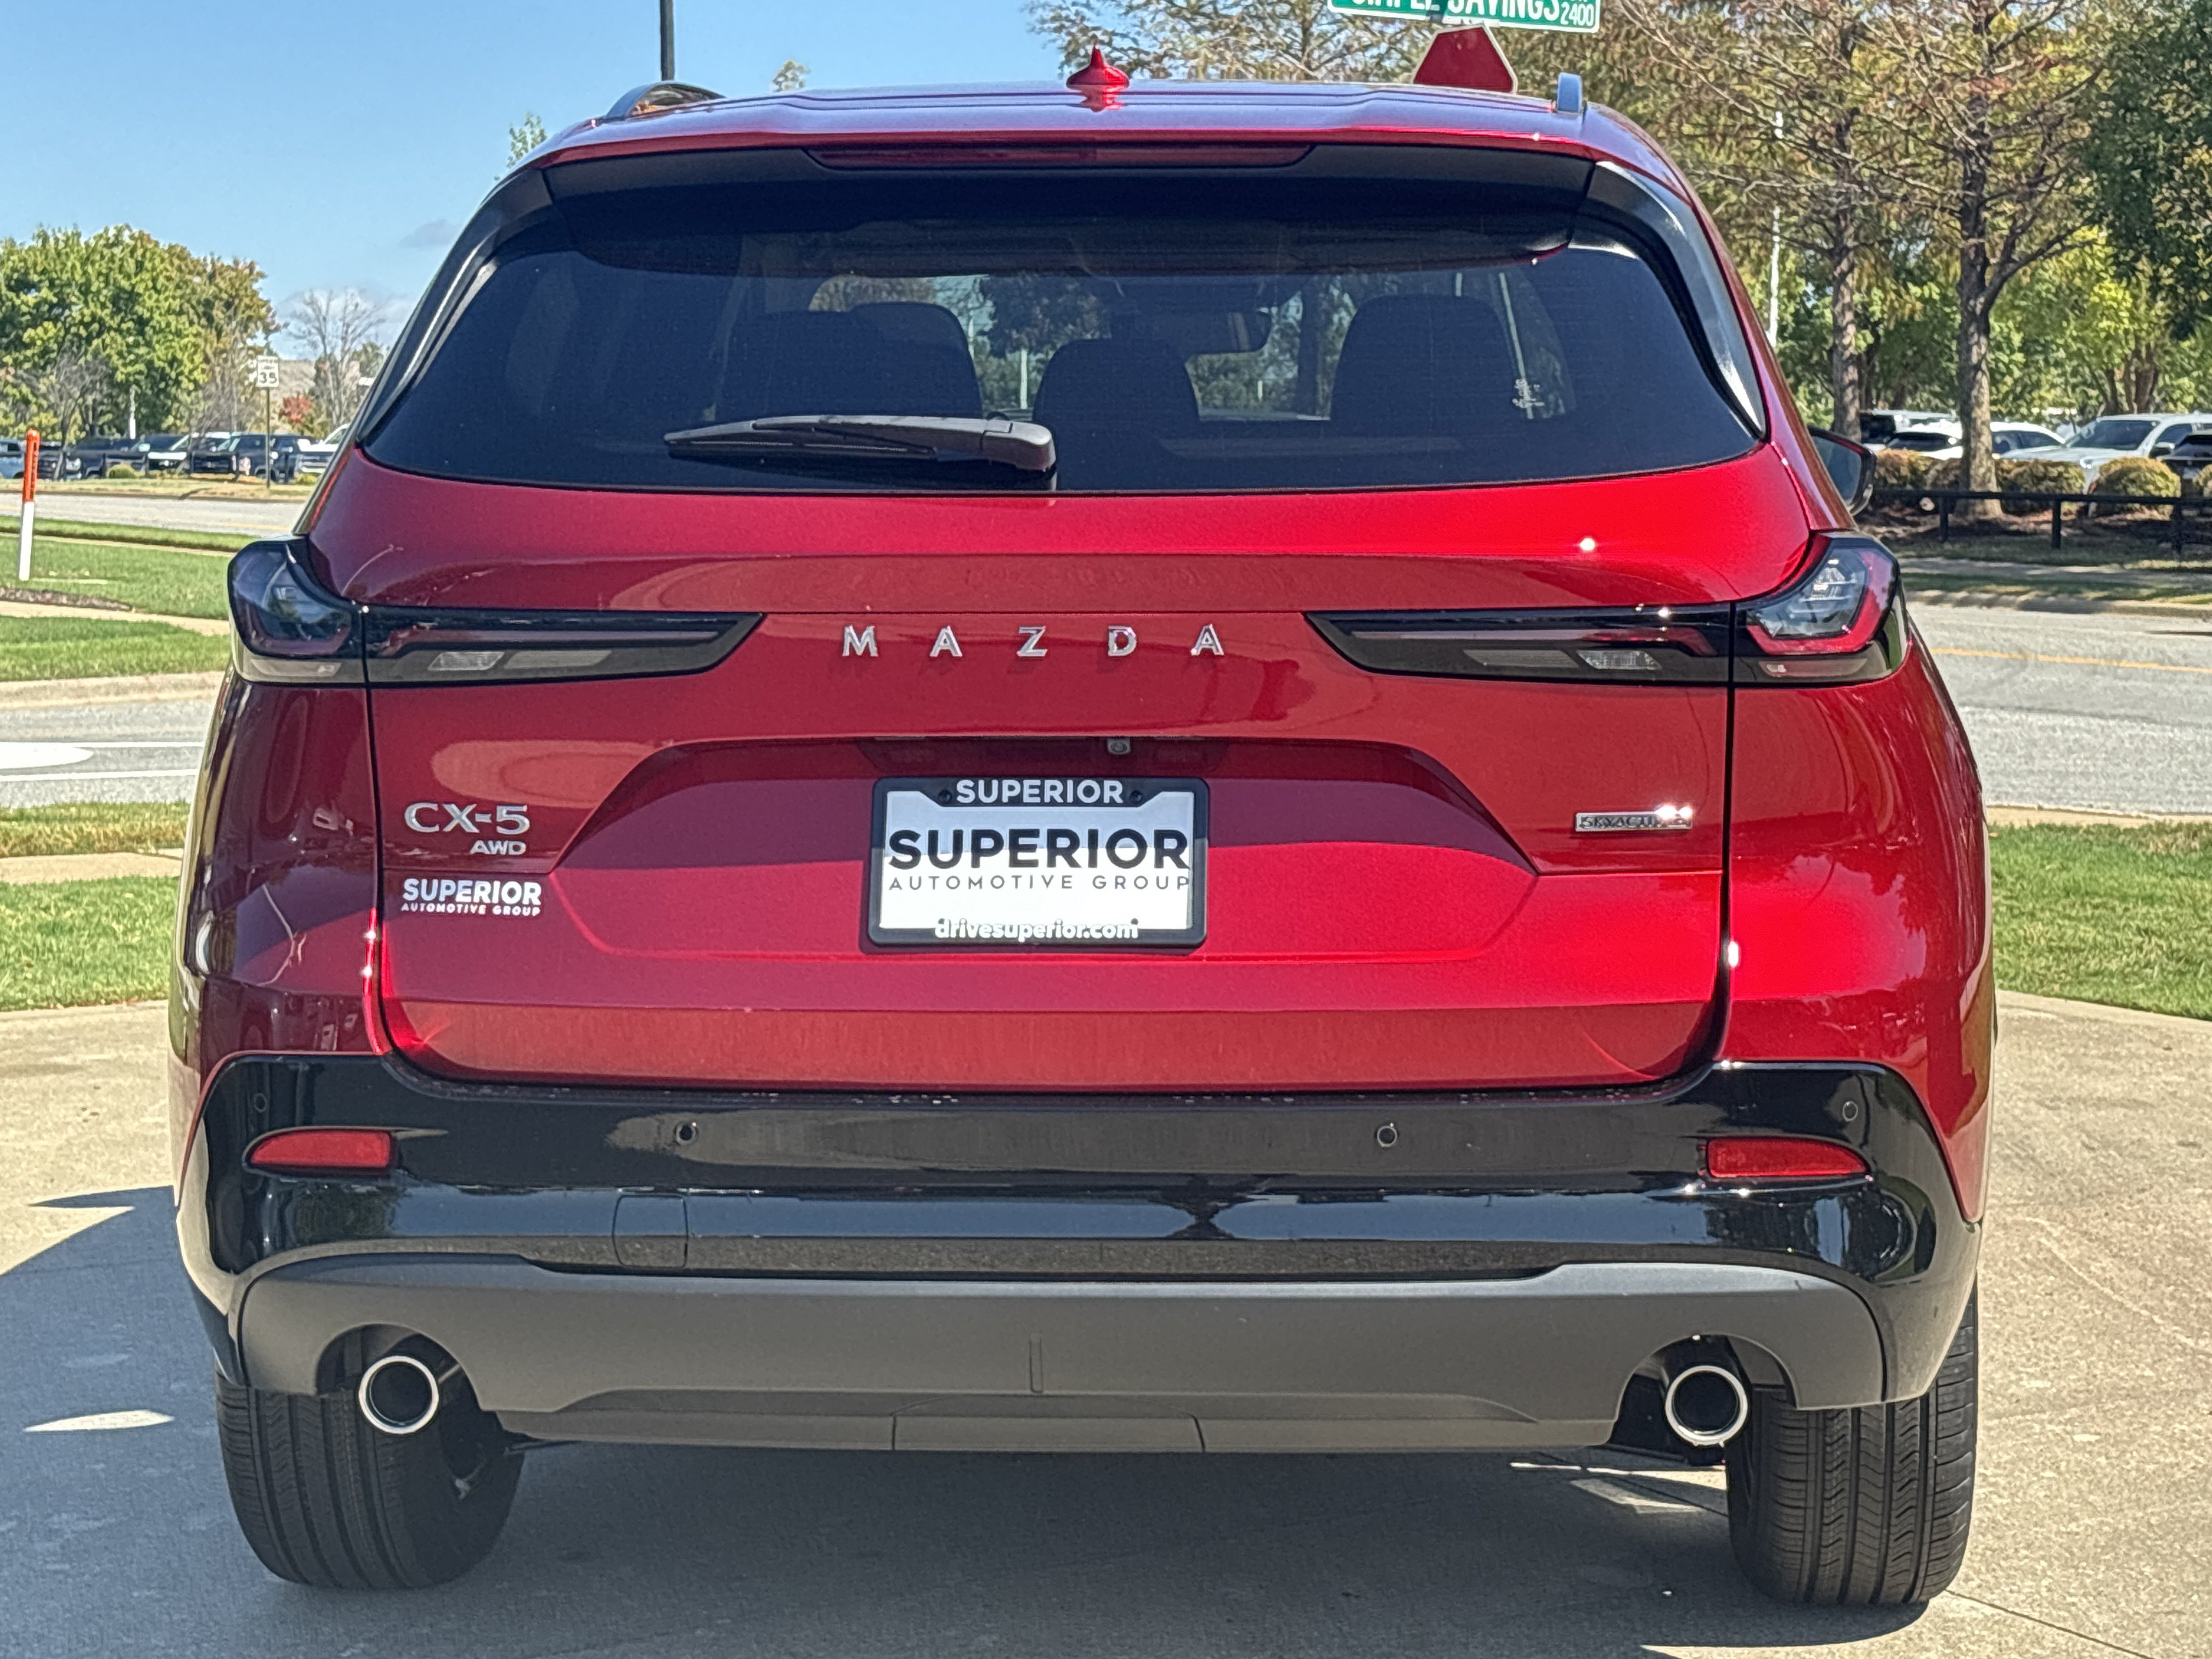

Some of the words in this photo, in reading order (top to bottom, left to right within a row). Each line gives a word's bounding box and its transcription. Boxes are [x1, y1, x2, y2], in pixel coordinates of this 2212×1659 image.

[1560, 3, 1594, 26] 2400
[259, 371, 278, 384] 35
[842, 624, 1224, 657] MAZDA
[956, 779, 1124, 804] SUPERIOR
[404, 802, 531, 835] CX-5
[470, 840, 527, 855] AWD
[888, 828, 1190, 870] SUPERIOR
[403, 878, 541, 905] SUPERIOR
[889, 875, 1073, 890] AUTOMOTIVE
[1092, 874, 1190, 890] GROUP
[400, 902, 486, 915] AUTOMOTIVE
[492, 905, 541, 916] GROUP
[935, 918, 1138, 943] drivesuperior.com
